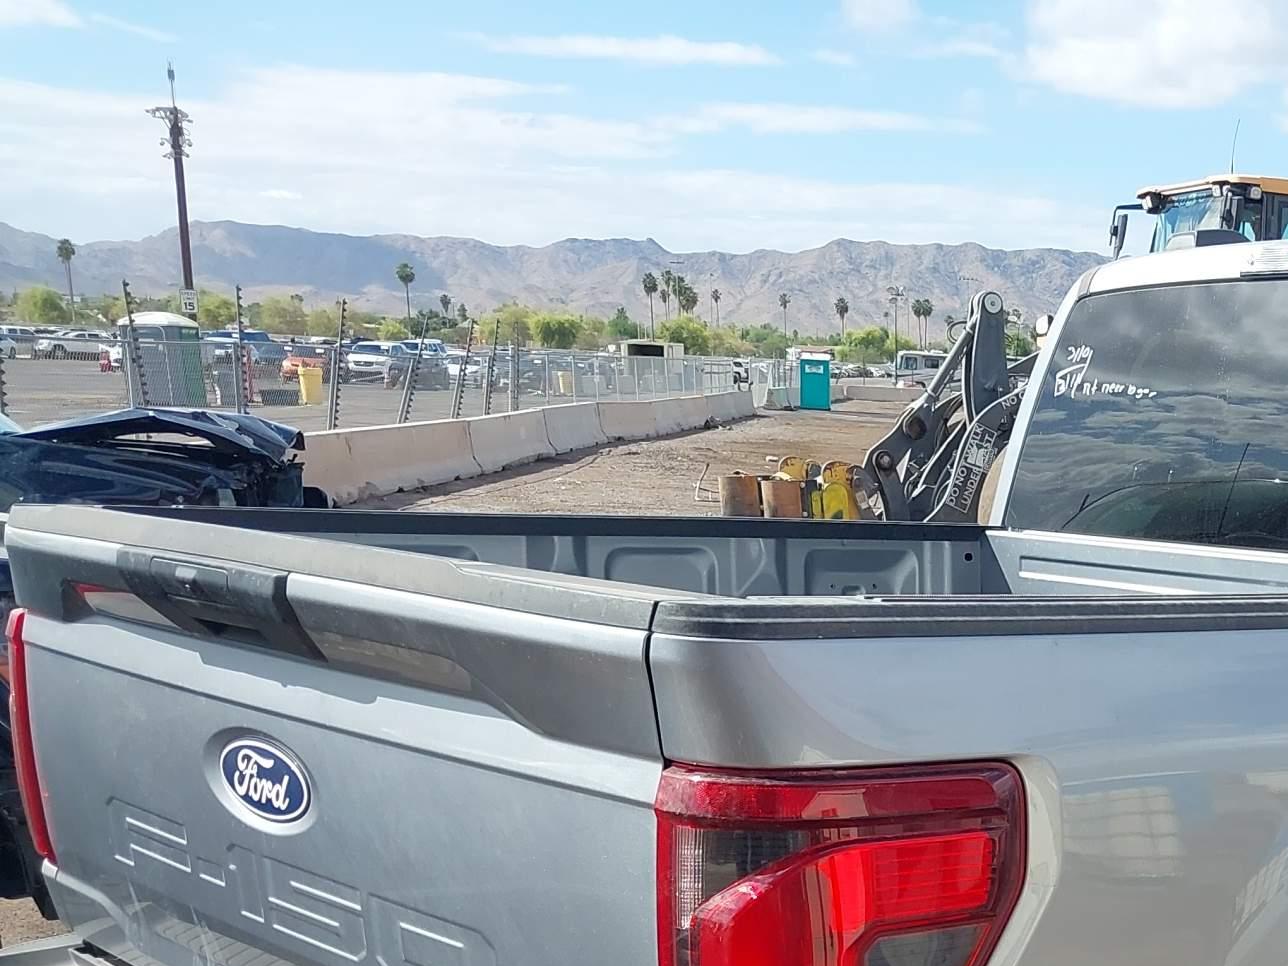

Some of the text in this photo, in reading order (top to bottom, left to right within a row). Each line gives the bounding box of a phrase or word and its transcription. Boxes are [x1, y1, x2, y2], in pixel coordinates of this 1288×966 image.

[184, 302, 195, 311] 15
[1001, 396, 1017, 410] NO
[233, 748, 289, 810] Ford
